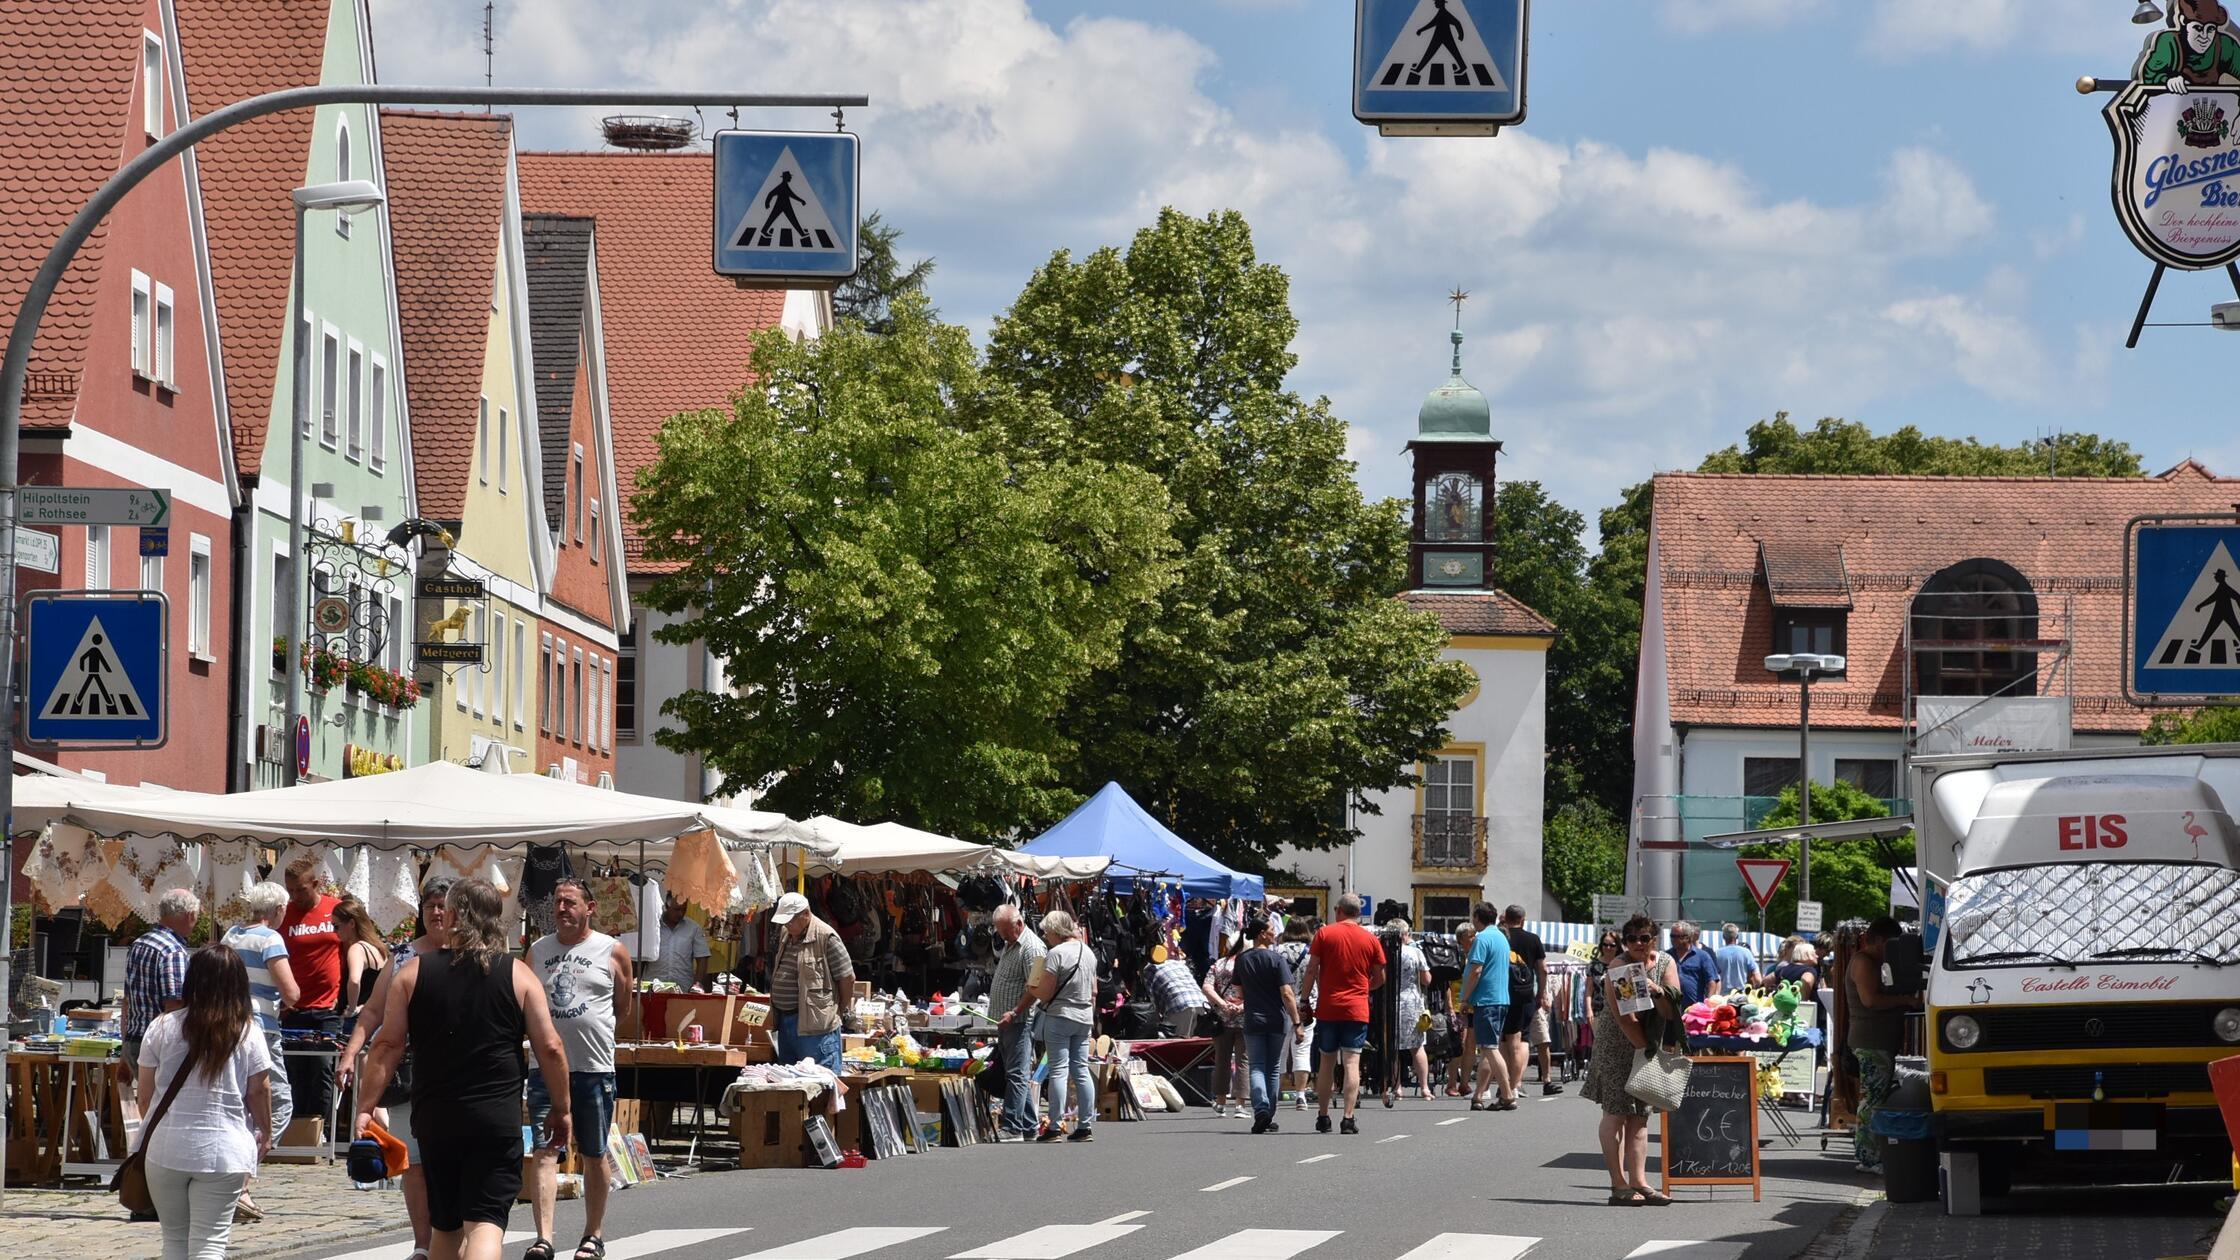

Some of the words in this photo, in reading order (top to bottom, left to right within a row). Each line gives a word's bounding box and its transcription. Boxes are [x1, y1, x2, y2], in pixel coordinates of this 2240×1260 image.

[2144, 149, 2240, 209] Glossne
[2200, 180, 2240, 207] Bie
[2159, 210, 2183, 226] Der
[2187, 212, 2239, 232] hochfeine
[2166, 227, 2232, 248] Biergenuss
[23, 492, 90, 505] Hilpoltstein
[39, 508, 87, 519] Rothsee
[425, 582, 478, 594] Gasthof
[1967, 735, 2013, 747] Maler
[2058, 813, 2128, 850] EIS
[544, 954, 561, 968] SUR
[561, 953, 572, 963] LA
[573, 955, 593, 968] MER
[2020, 976, 2090, 993] Castello
[2096, 974, 2180, 991] Eismobil
[550, 1002, 589, 1019] OYAGEUR
[1685, 1160, 1715, 1175] Kugel
